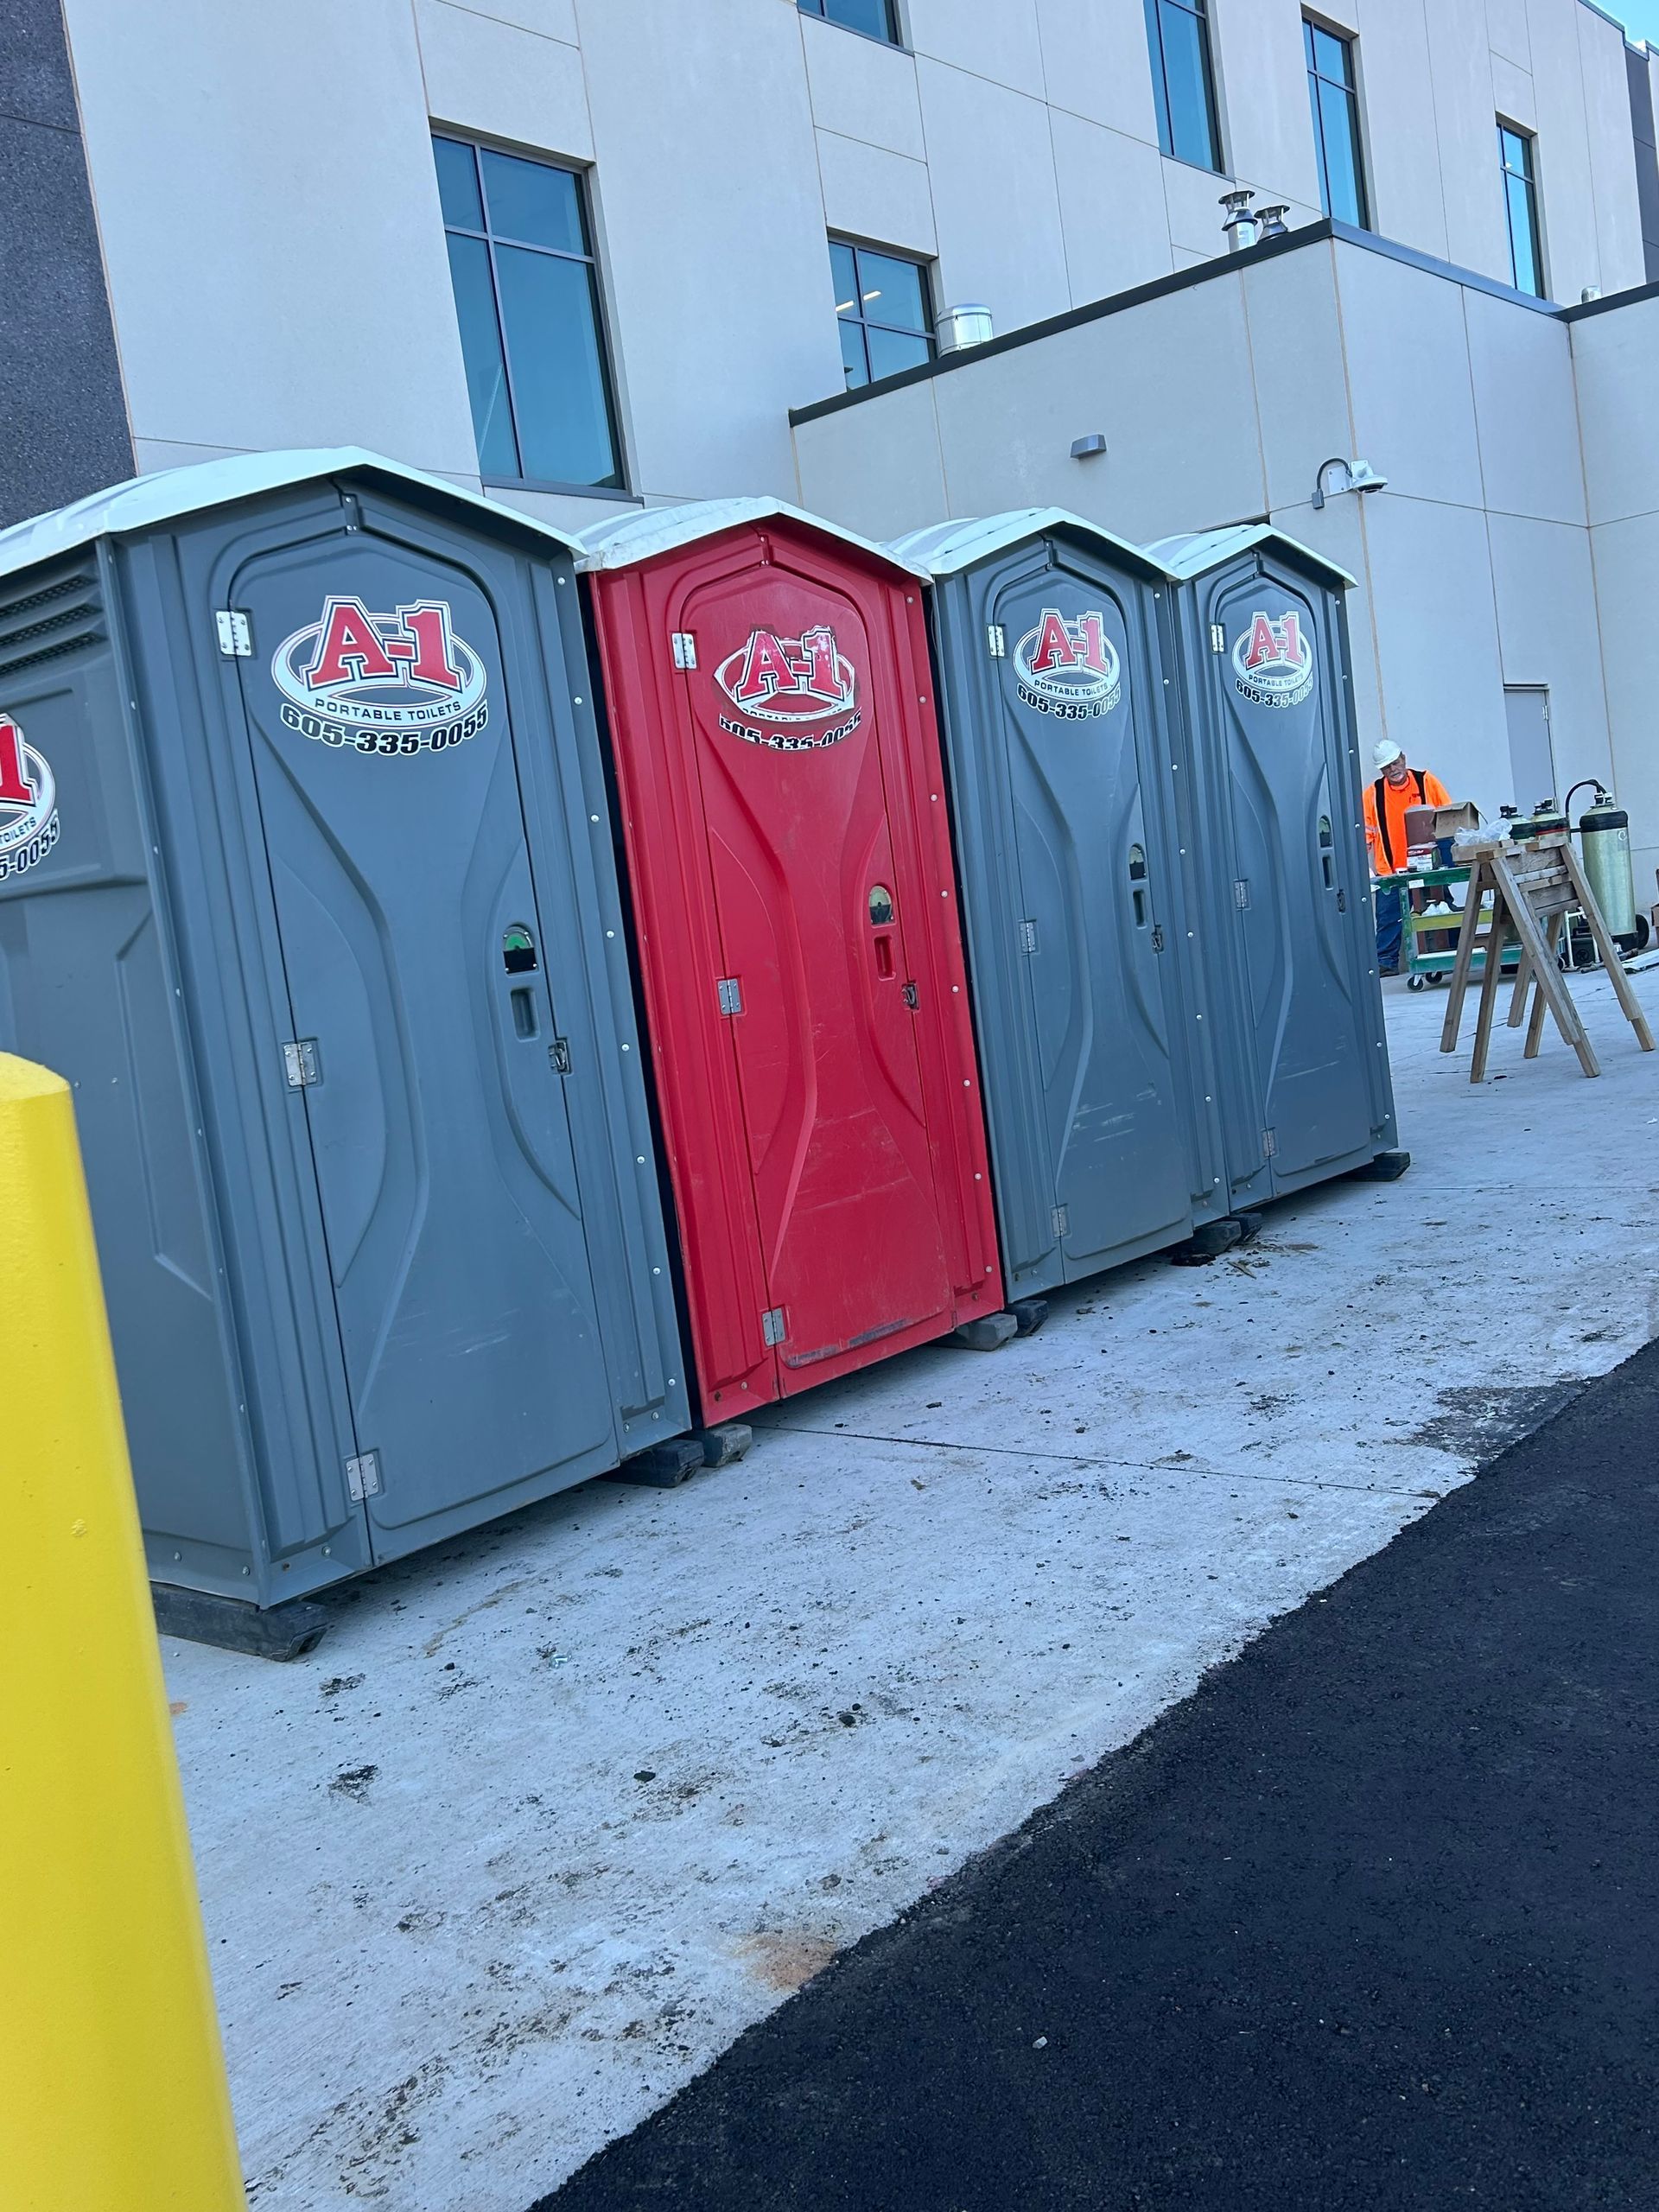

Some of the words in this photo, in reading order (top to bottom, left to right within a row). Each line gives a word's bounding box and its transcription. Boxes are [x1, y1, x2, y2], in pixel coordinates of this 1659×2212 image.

[304, 596, 464, 694] A-1
[735, 627, 846, 702] A-1
[1029, 609, 1109, 677] A-1
[1244, 612, 1305, 671] A-1
[315, 697, 402, 721] PORTABLE
[408, 701, 461, 721] TOILETS
[1034, 679, 1079, 696] PORTABLE
[1249, 674, 1283, 687] PORTABLE
[280, 699, 487, 755] 605-335-0055
